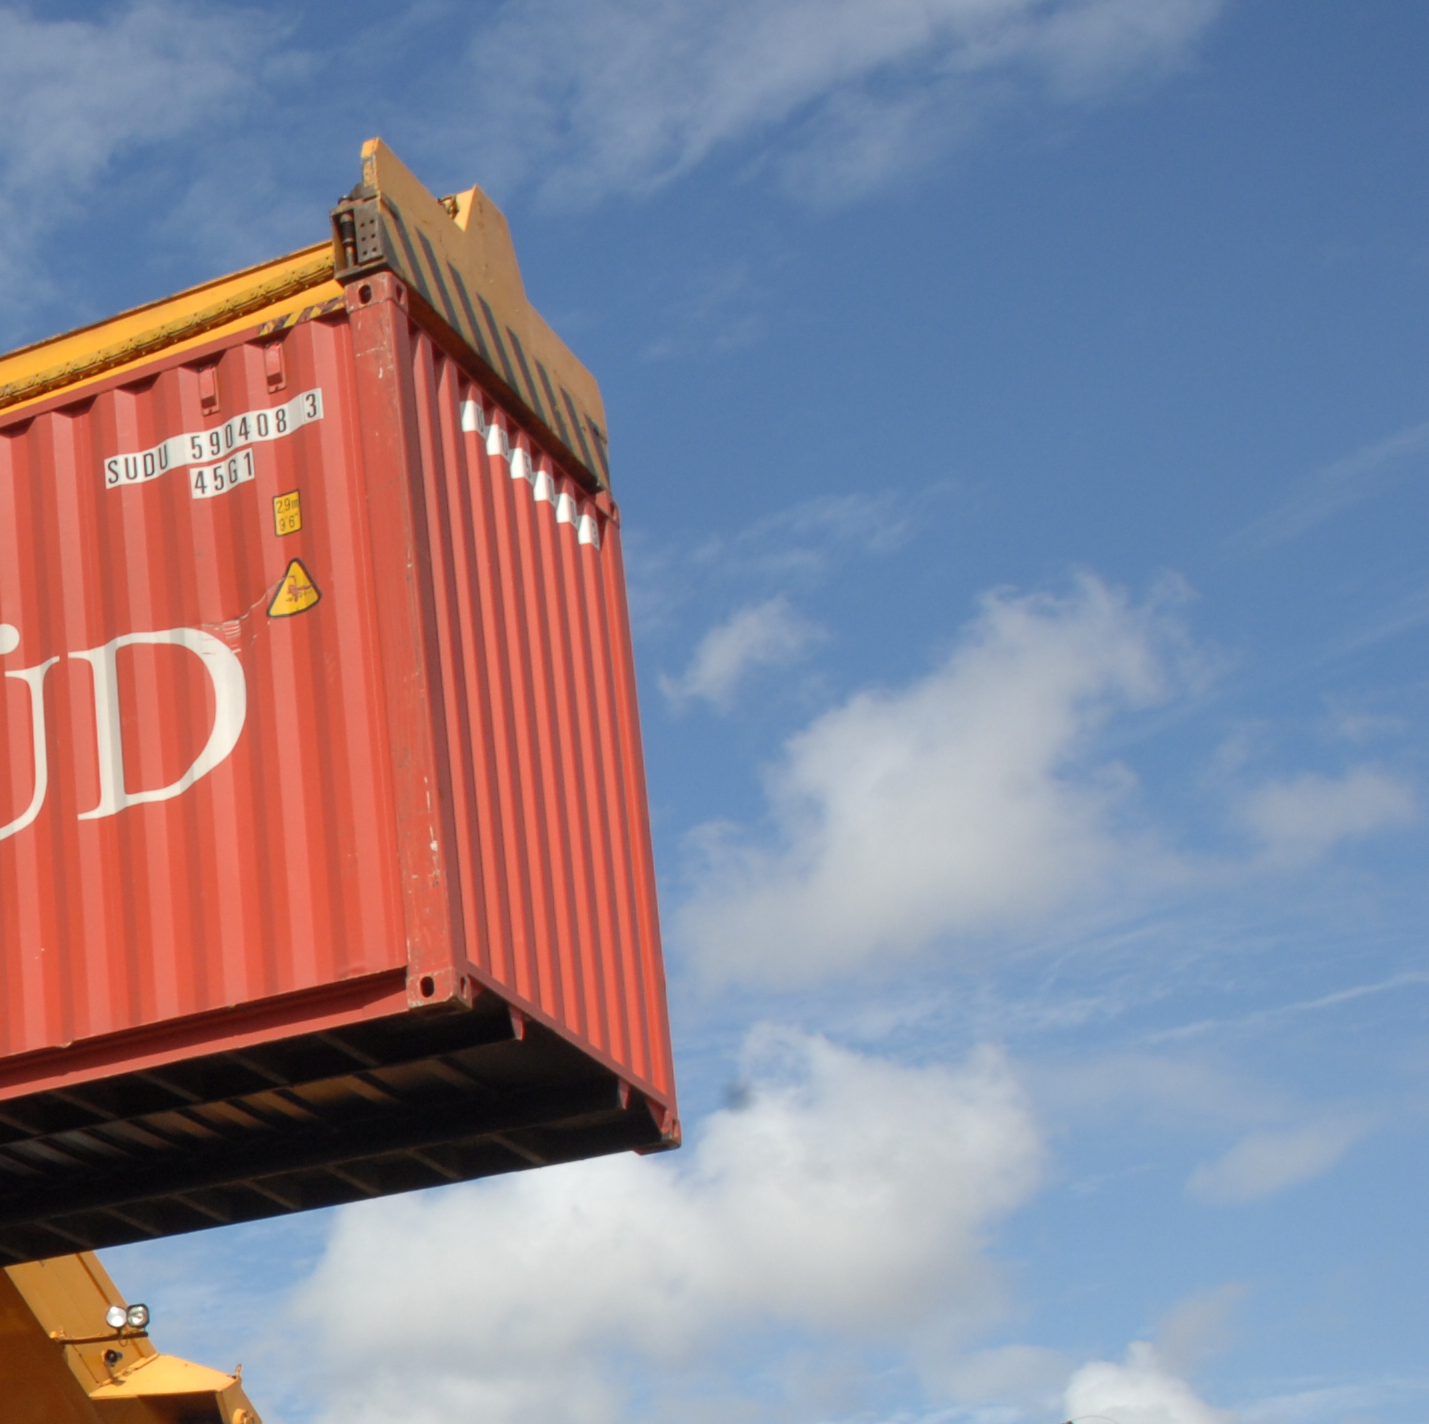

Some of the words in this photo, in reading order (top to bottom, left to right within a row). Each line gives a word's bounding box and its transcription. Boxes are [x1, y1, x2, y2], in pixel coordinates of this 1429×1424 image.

[107, 444, 169, 484] SUDU
[191, 408, 287, 460] 590408
[305, 393, 317, 418] 3
[194, 451, 253, 494] 45G1
